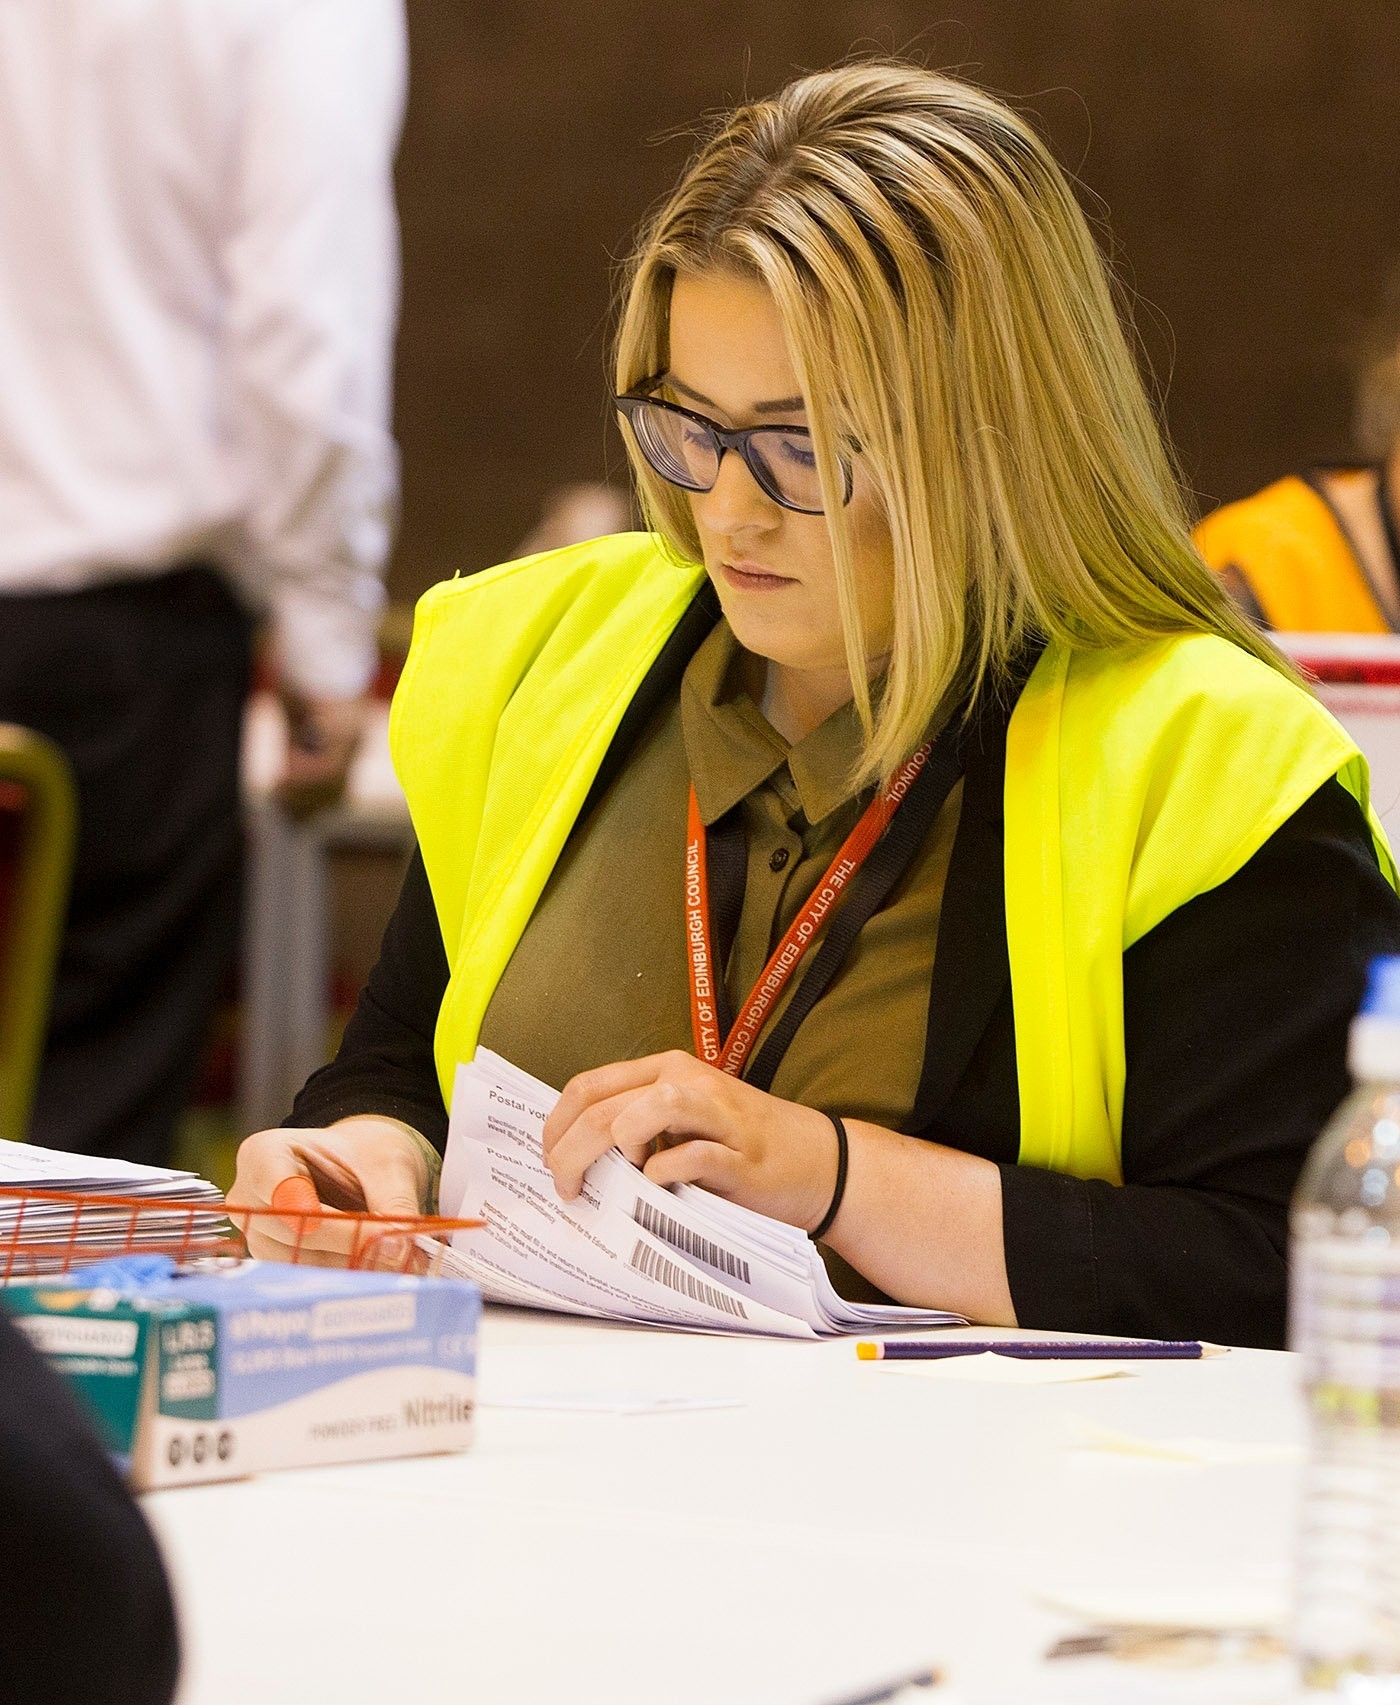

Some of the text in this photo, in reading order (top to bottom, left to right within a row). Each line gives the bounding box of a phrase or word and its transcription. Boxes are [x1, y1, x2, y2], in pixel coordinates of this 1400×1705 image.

[886, 743, 931, 802] COUNCIL
[829, 858, 856, 889] THE
[808, 889, 835, 924] CITY
[795, 921, 813, 945] OF
[687, 839, 718, 1061] CITY OF EDINBURGH COUNCIL
[743, 941, 800, 1029] EDINBURGH
[489, 1090, 525, 1112] Postal
[487, 1122, 506, 1135] West
[507, 1131, 525, 1147] Burgh
[488, 1115, 517, 1131] Election
[487, 1146, 523, 1166] Postal
[491, 1174, 508, 1188] West
[508, 1184, 526, 1199] Burgh
[491, 1166, 519, 1185] Election
[527, 1184, 549, 1203] Member
[553, 1204, 577, 1229] Parliament
[583, 1230, 592, 1241] the
[591, 1236, 618, 1260] Edinburgh
[507, 1230, 526, 1249] Please
[525, 1243, 539, 1257] read
[538, 1253, 549, 1263] the
[546, 1247, 558, 1259] and
[558, 1255, 576, 1271] return
[576, 1265, 588, 1277] this
